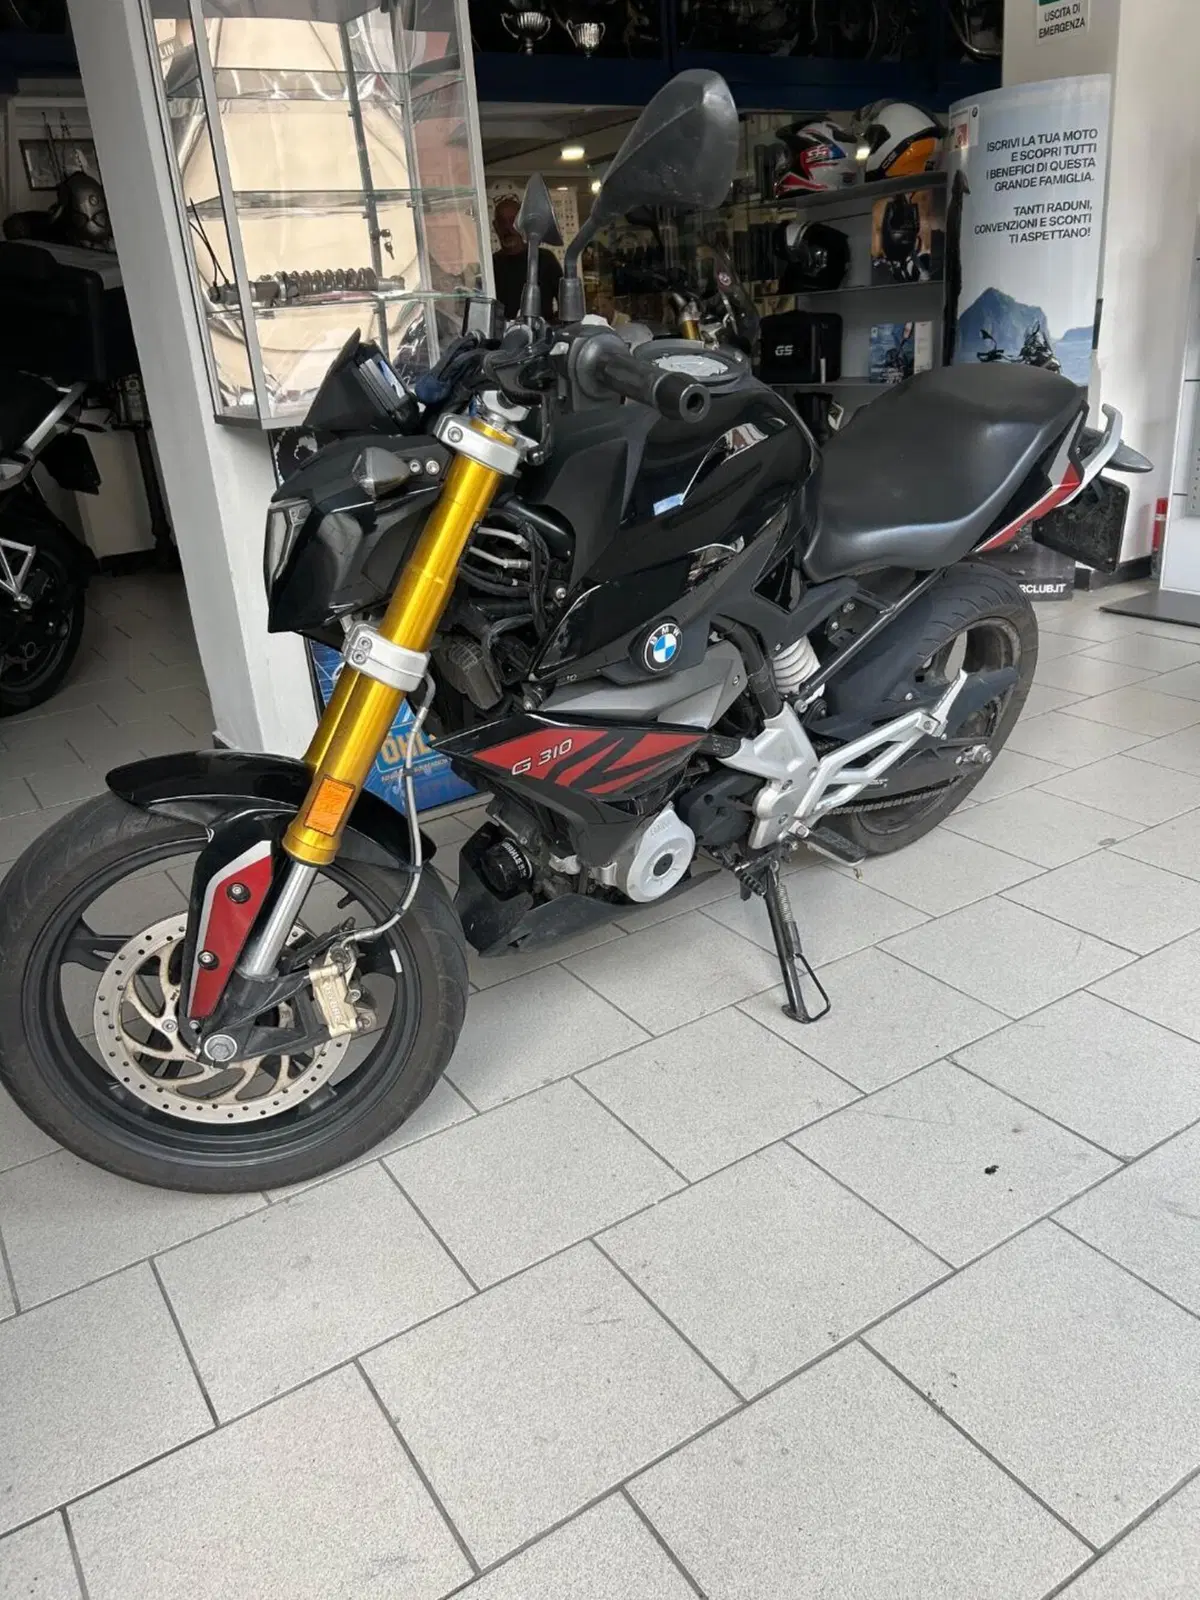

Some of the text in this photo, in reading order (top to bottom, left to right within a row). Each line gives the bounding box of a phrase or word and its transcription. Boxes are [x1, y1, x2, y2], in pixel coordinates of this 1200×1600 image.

[1044, 3, 1081, 22] USCITA DI
[1039, 17, 1085, 39] EMERGENZA
[987, 128, 1099, 152] ISCRIVI LA TUA MOTO
[1011, 143, 1097, 162] E SCOPRI TUTTI
[990, 163, 1035, 179] BENEFICI
[1037, 162, 1048, 173] DI
[1050, 157, 1096, 171] QUESTA
[994, 172, 1095, 192] GRANDE FAMIGLIA.
[1014, 200, 1092, 216] TANTI RADUNI,
[974, 213, 1092, 235] CONVENZIONI E SCONTI
[1009, 227, 1091, 244] TI ASPETTANO!
[775, 345, 794, 356] GS
[650, 626, 681, 646] BMW
[512, 739, 572, 775] G 310
